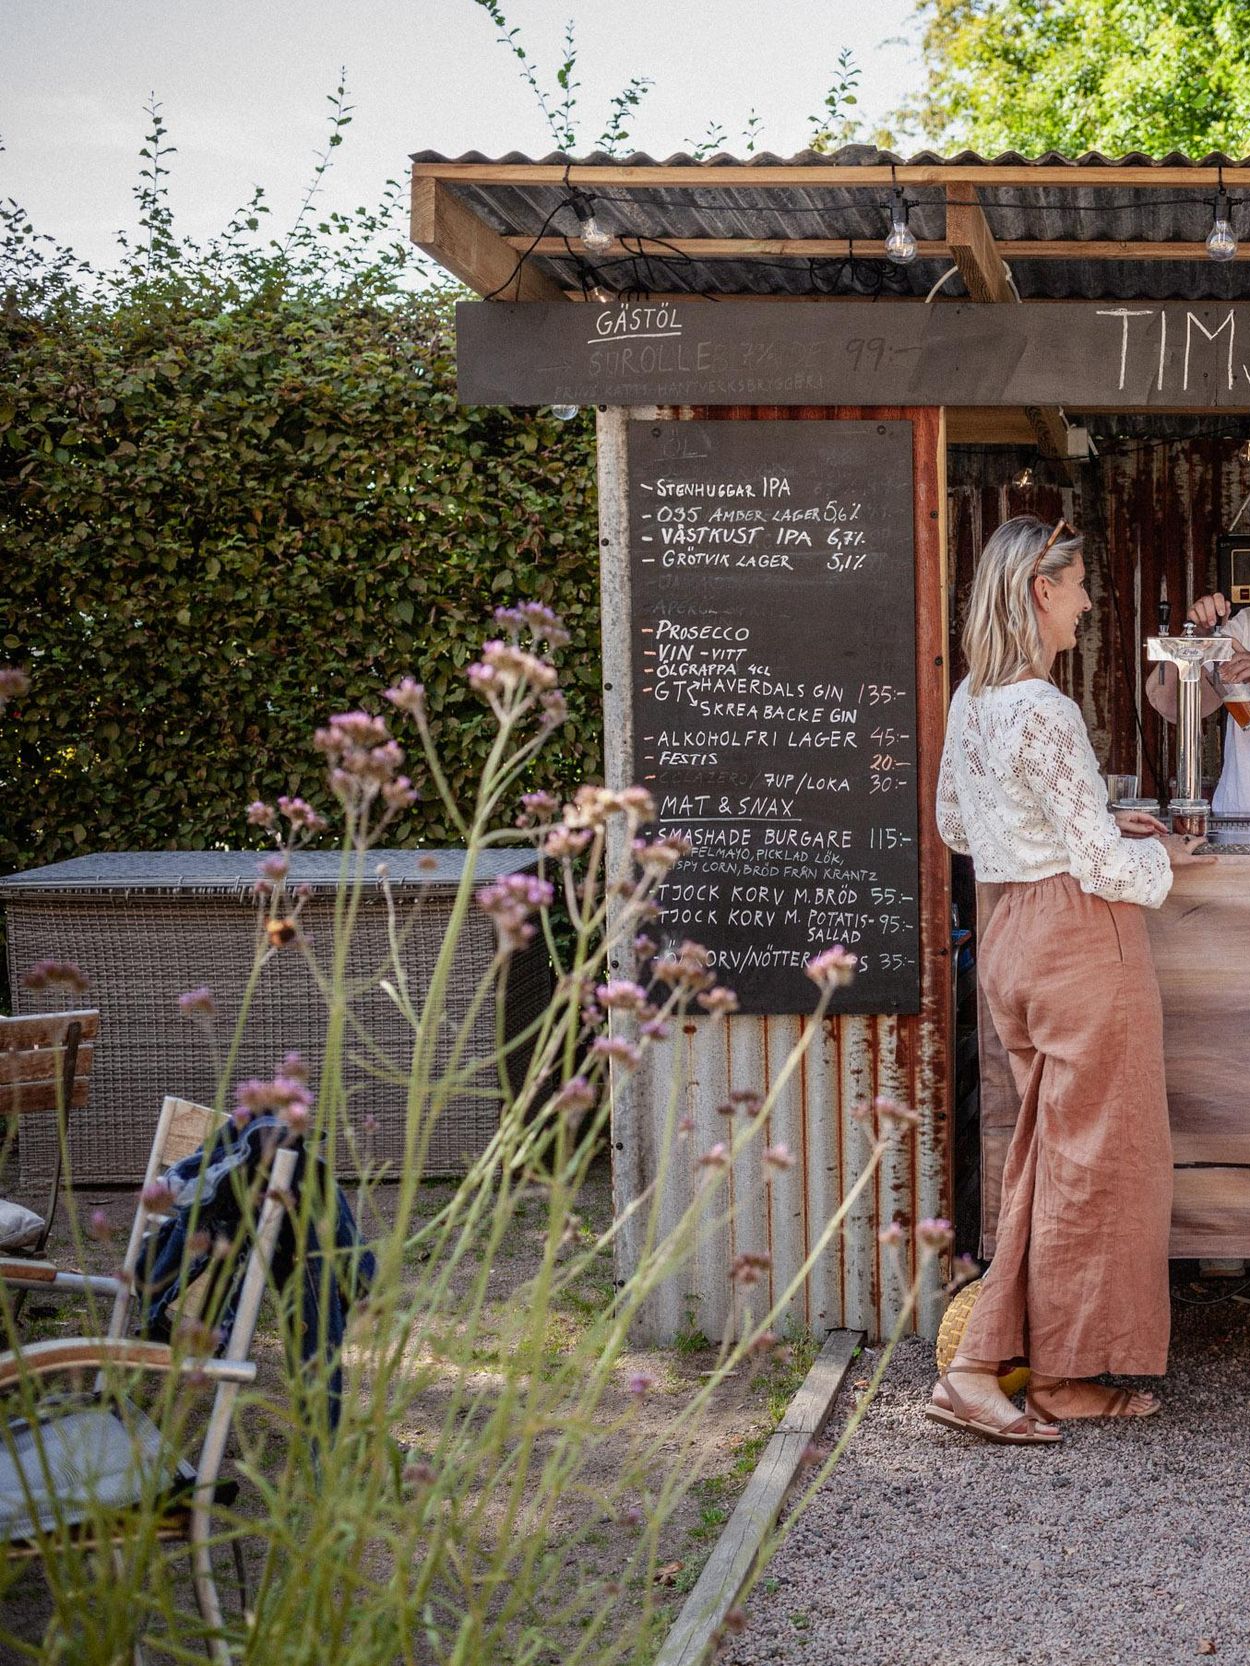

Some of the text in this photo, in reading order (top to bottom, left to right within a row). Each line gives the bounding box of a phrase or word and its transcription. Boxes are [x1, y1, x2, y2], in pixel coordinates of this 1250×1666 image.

[596, 303, 682, 335] GÄSTÖL
[656, 477, 791, 497] STENHUGGAR IPA
[708, 507, 767, 523] AMBER
[772, 508, 821, 523] LAGER
[823, 500, 862, 525] 5,6%
[776, 527, 813, 547] IPA
[827, 528, 866, 549] 6,7%
[662, 546, 867, 572] GRÖTVIK LAGER 5,1%
[656, 619, 750, 641] PROSECCO
[659, 644, 694, 661] VIN
[656, 659, 771, 678] ÖLGRAPPA 4CL
[701, 678, 804, 698] HAVERDALS
[813, 684, 844, 702] GIN
[829, 709, 857, 723] GIN
[657, 726, 910, 748] ALKOHOLFRI LAGER 45:-
[659, 751, 718, 766] FESTIS
[660, 795, 794, 817] MAT & SNAX
[658, 828, 752, 847] SMASHADE
[764, 830, 852, 849] BURGARE
[783, 865, 818, 880] FRÅN
[658, 884, 720, 903] TJOCK
[731, 885, 785, 905] KORV
[658, 909, 718, 925] TJOCK
[728, 911, 775, 927] KORV
[807, 910, 875, 928] POTATIS-
[807, 928, 861, 944] SALLAD
